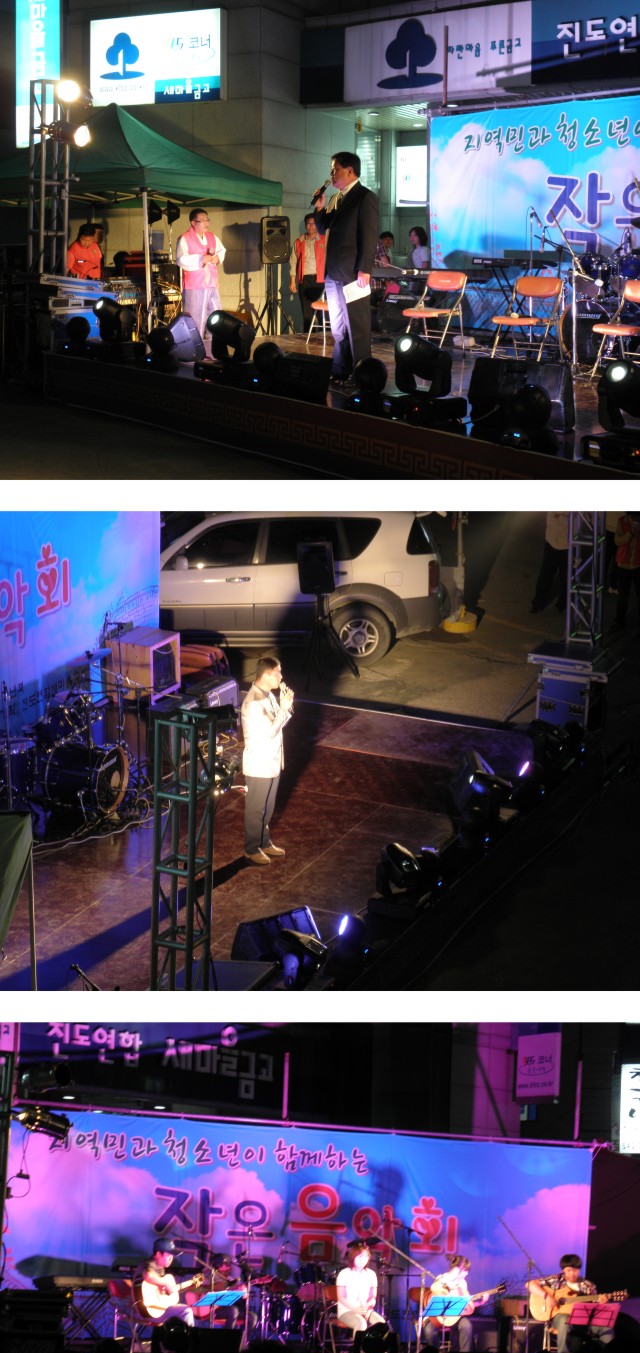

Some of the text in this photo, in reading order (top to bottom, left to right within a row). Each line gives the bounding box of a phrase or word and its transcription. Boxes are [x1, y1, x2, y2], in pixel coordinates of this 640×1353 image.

[163, 78, 210, 100] 새마을금고
[464, 112, 640, 154] 지역민과 청소년
[47, 1022, 275, 1099] 진도연합 새마을금고
[162, 1127, 267, 1168] 청소년이
[273, 1136, 370, 1176] 함께하는
[289, 1182, 460, 1264] 음악회
